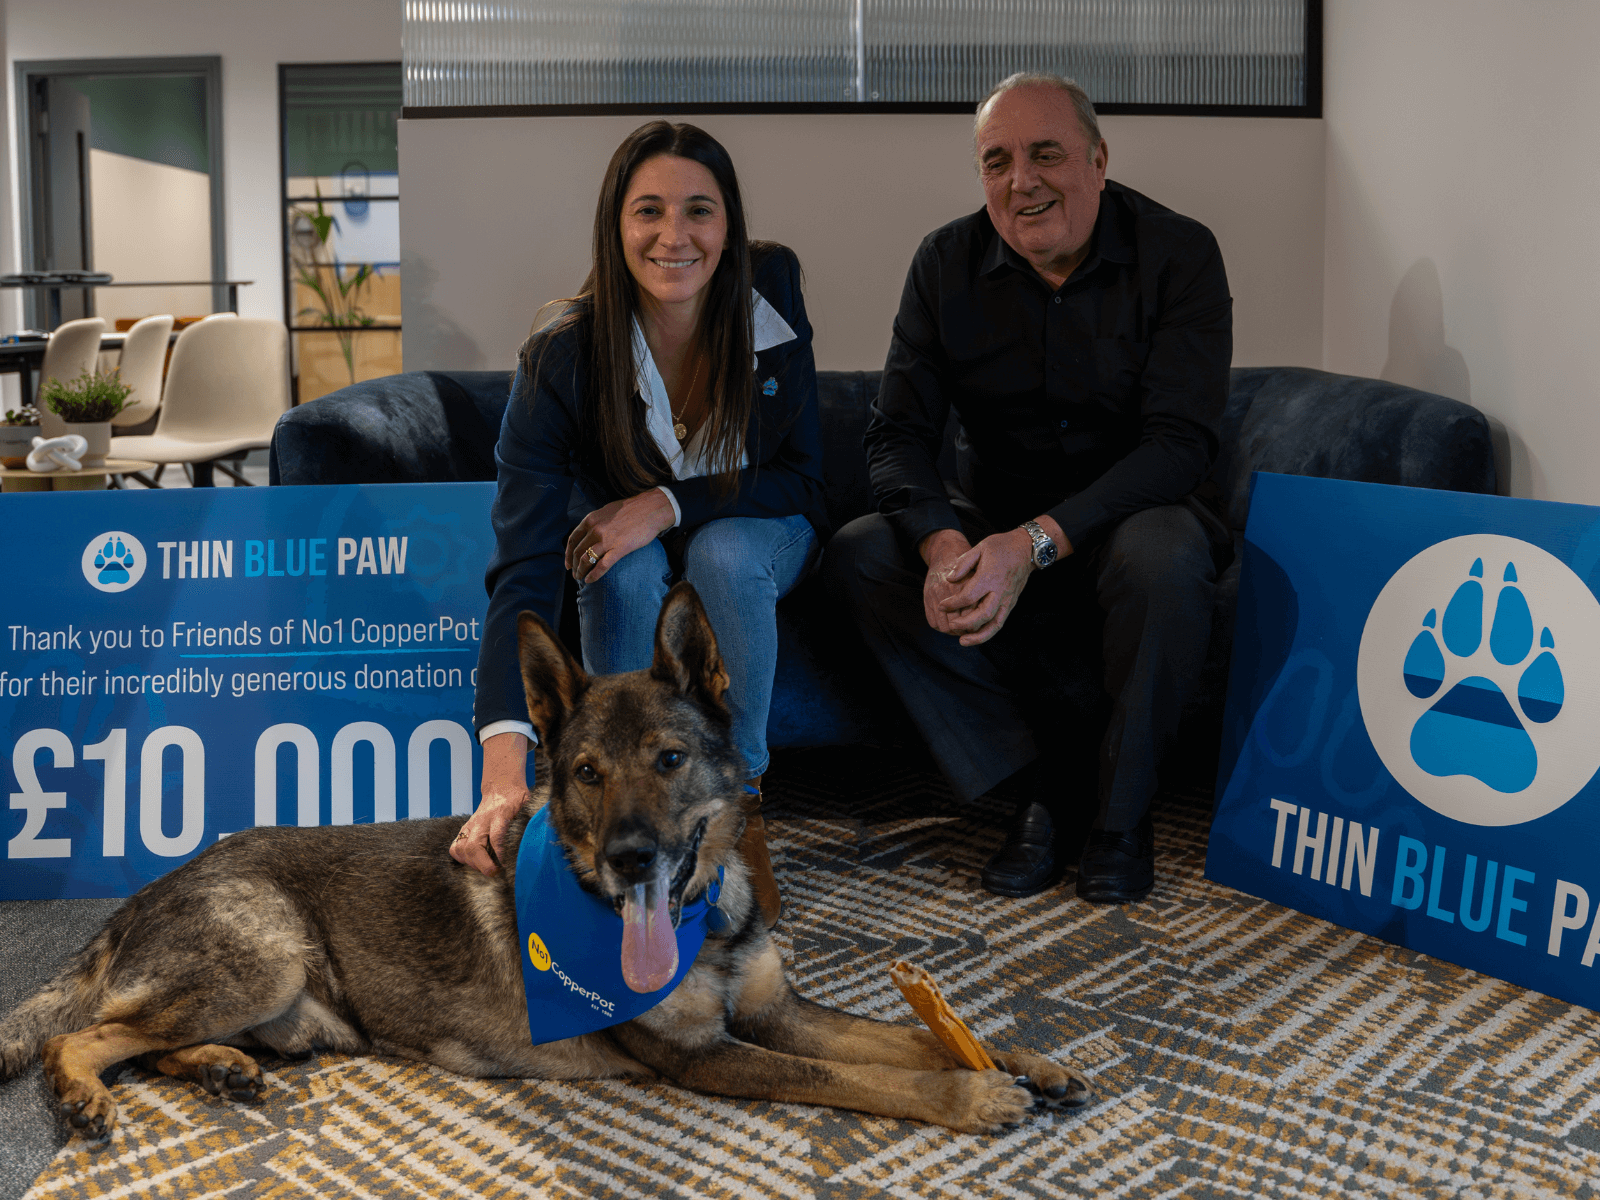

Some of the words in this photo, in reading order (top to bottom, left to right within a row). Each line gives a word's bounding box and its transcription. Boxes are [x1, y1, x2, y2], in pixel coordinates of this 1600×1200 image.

[157, 540, 234, 579] THIN
[244, 538, 328, 578] BLUE
[338, 536, 408, 575] PAW
[8, 624, 82, 651] Thank
[89, 630, 132, 655] you
[140, 624, 164, 648] to
[172, 620, 262, 647] Friends
[269, 619, 294, 645] of
[302, 618, 343, 644] No1
[351, 616, 480, 648] CopperPot
[0, 671, 33, 697] for
[40, 670, 98, 696] their
[105, 667, 224, 698] incredibly
[231, 671, 347, 698] generous
[354, 662, 462, 690] donation
[8, 719, 474, 859] £10000
[1270, 798, 1380, 898] THIN
[1390, 834, 1536, 947] BLUE
[531, 939, 549, 964] No1
[551, 961, 616, 1012] CopperPot
